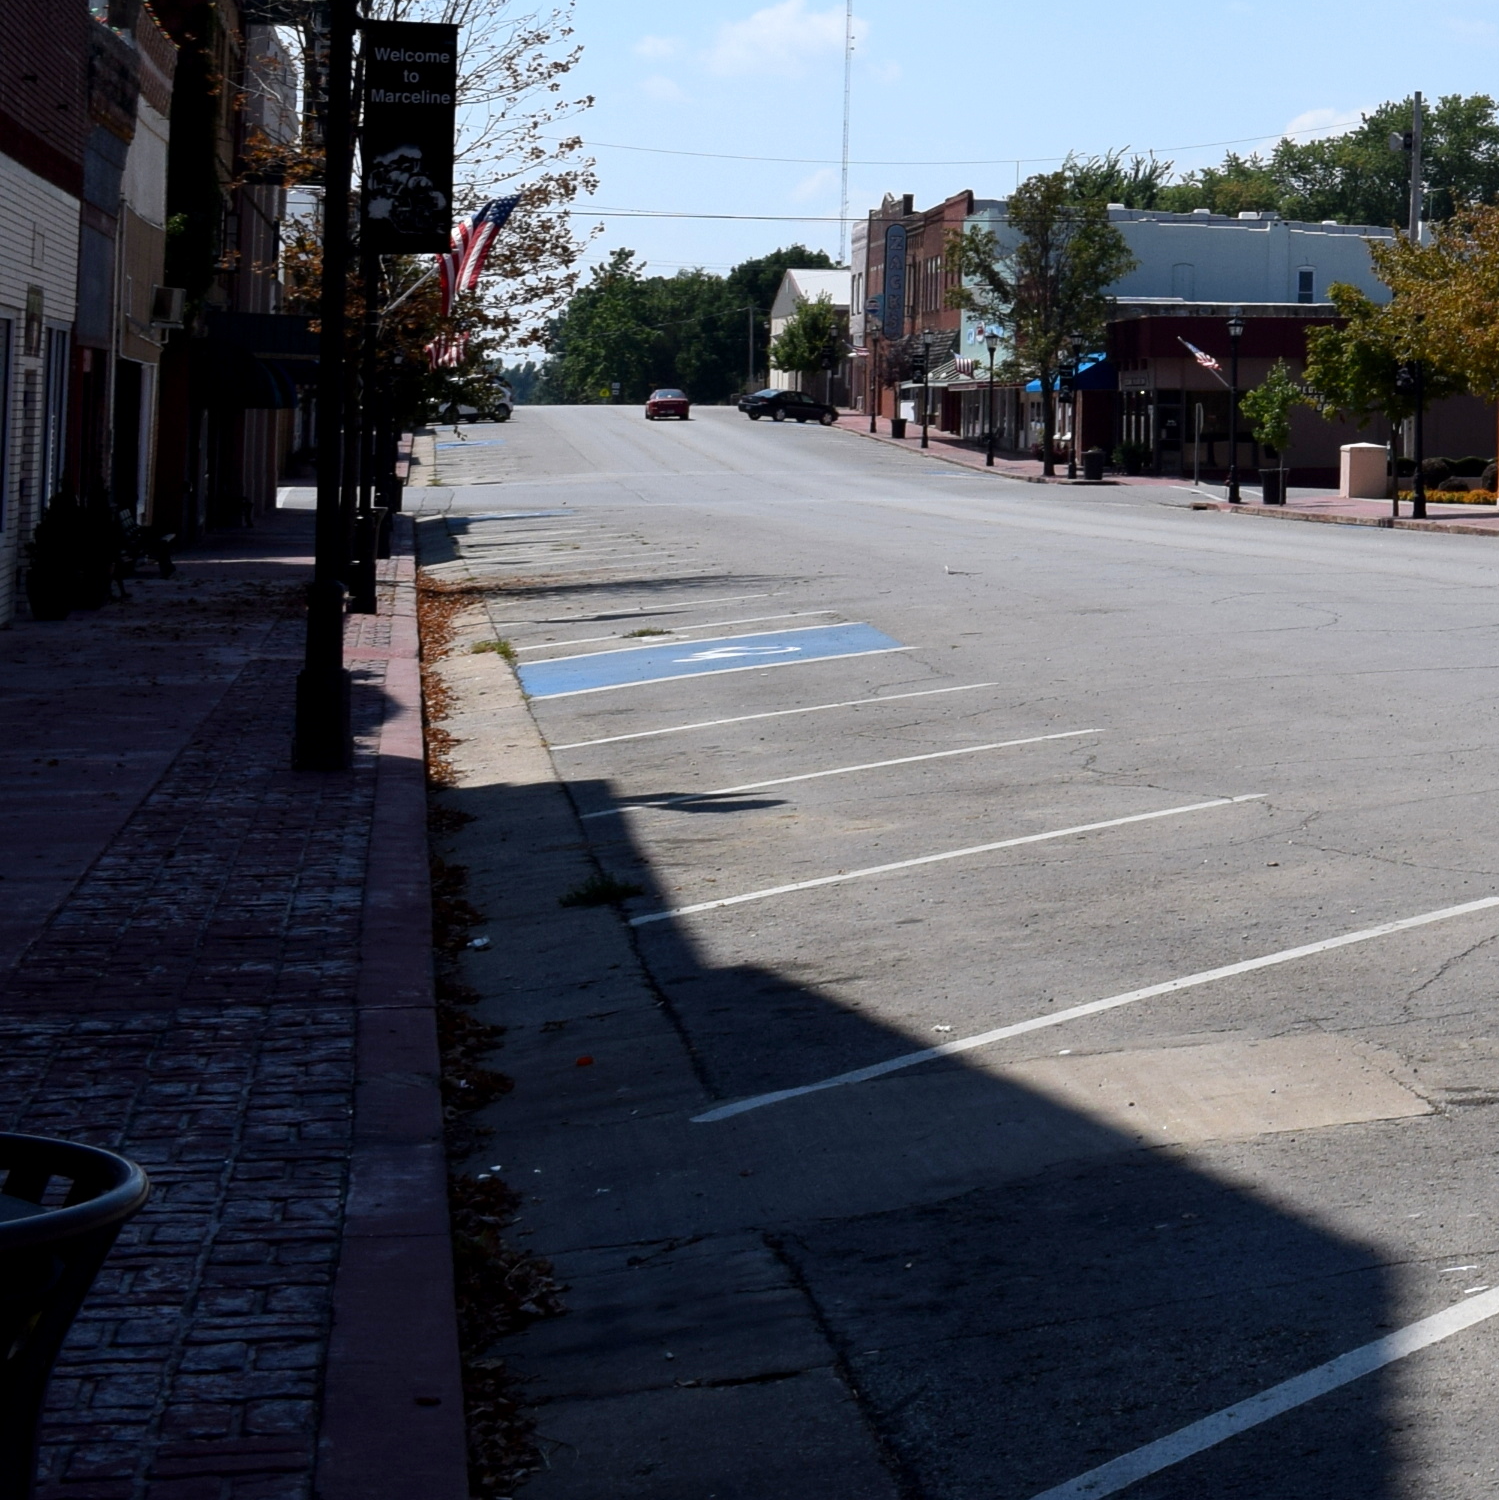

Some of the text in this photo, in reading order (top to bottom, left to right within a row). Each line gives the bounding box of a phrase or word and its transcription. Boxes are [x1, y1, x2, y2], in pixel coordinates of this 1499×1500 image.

[374, 46, 451, 64] Welcome
[403, 69, 420, 83] to
[371, 88, 452, 105] Marceline
